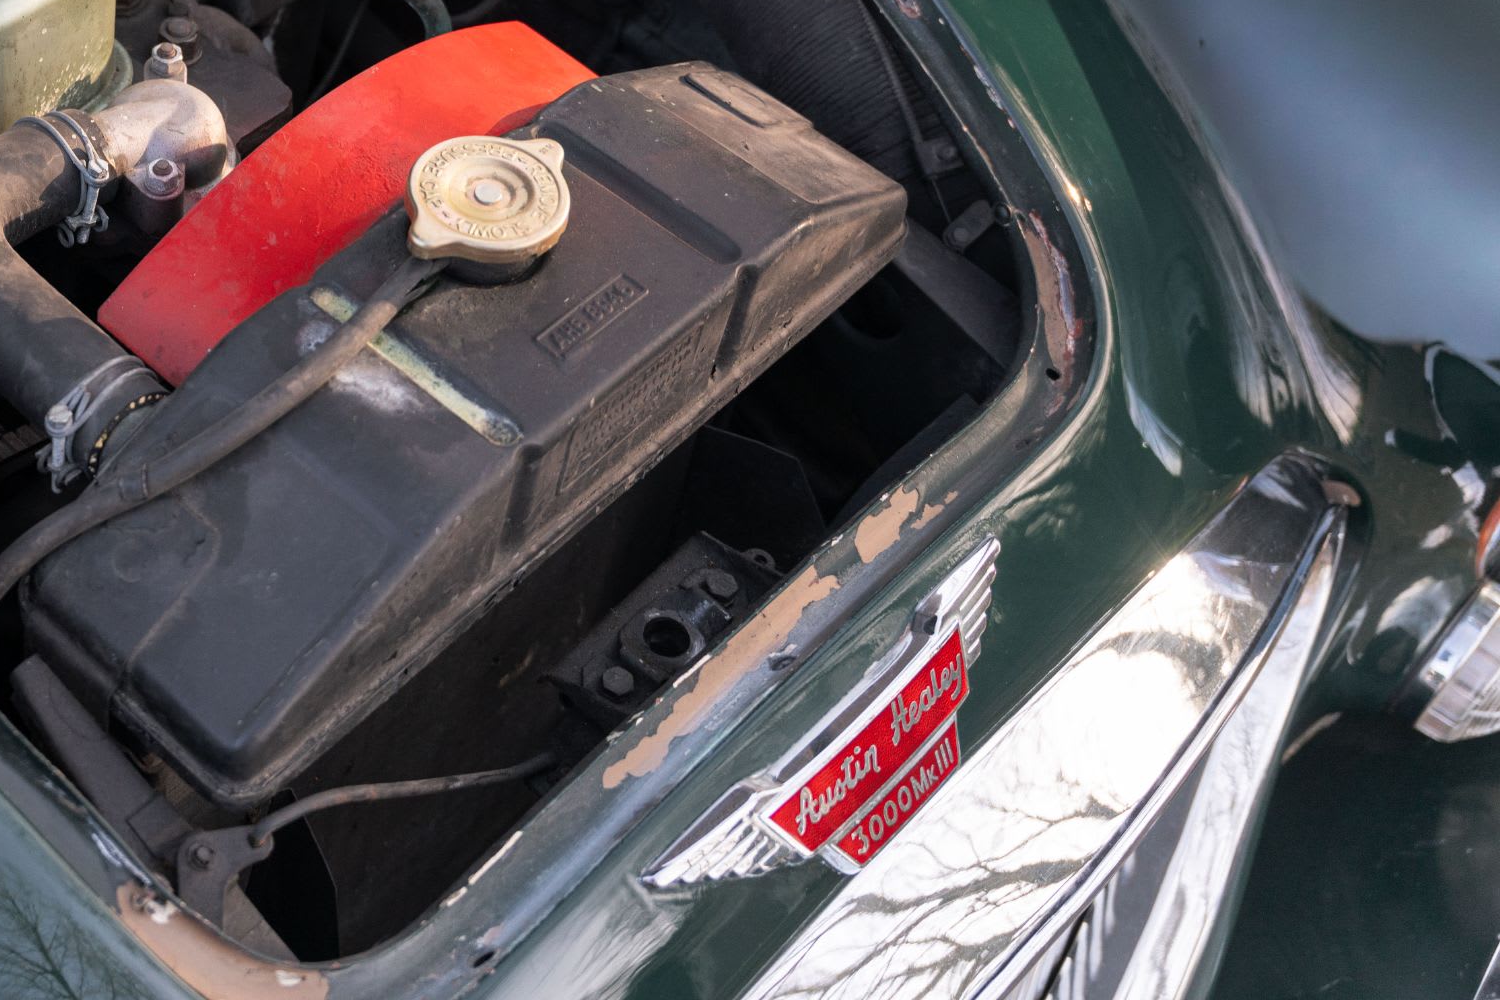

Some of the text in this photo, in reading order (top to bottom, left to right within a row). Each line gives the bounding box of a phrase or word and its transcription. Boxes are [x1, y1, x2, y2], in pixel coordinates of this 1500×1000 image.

[456, 218, 531, 239] SLOWLY
[795, 653, 962, 836] Austin Healey
